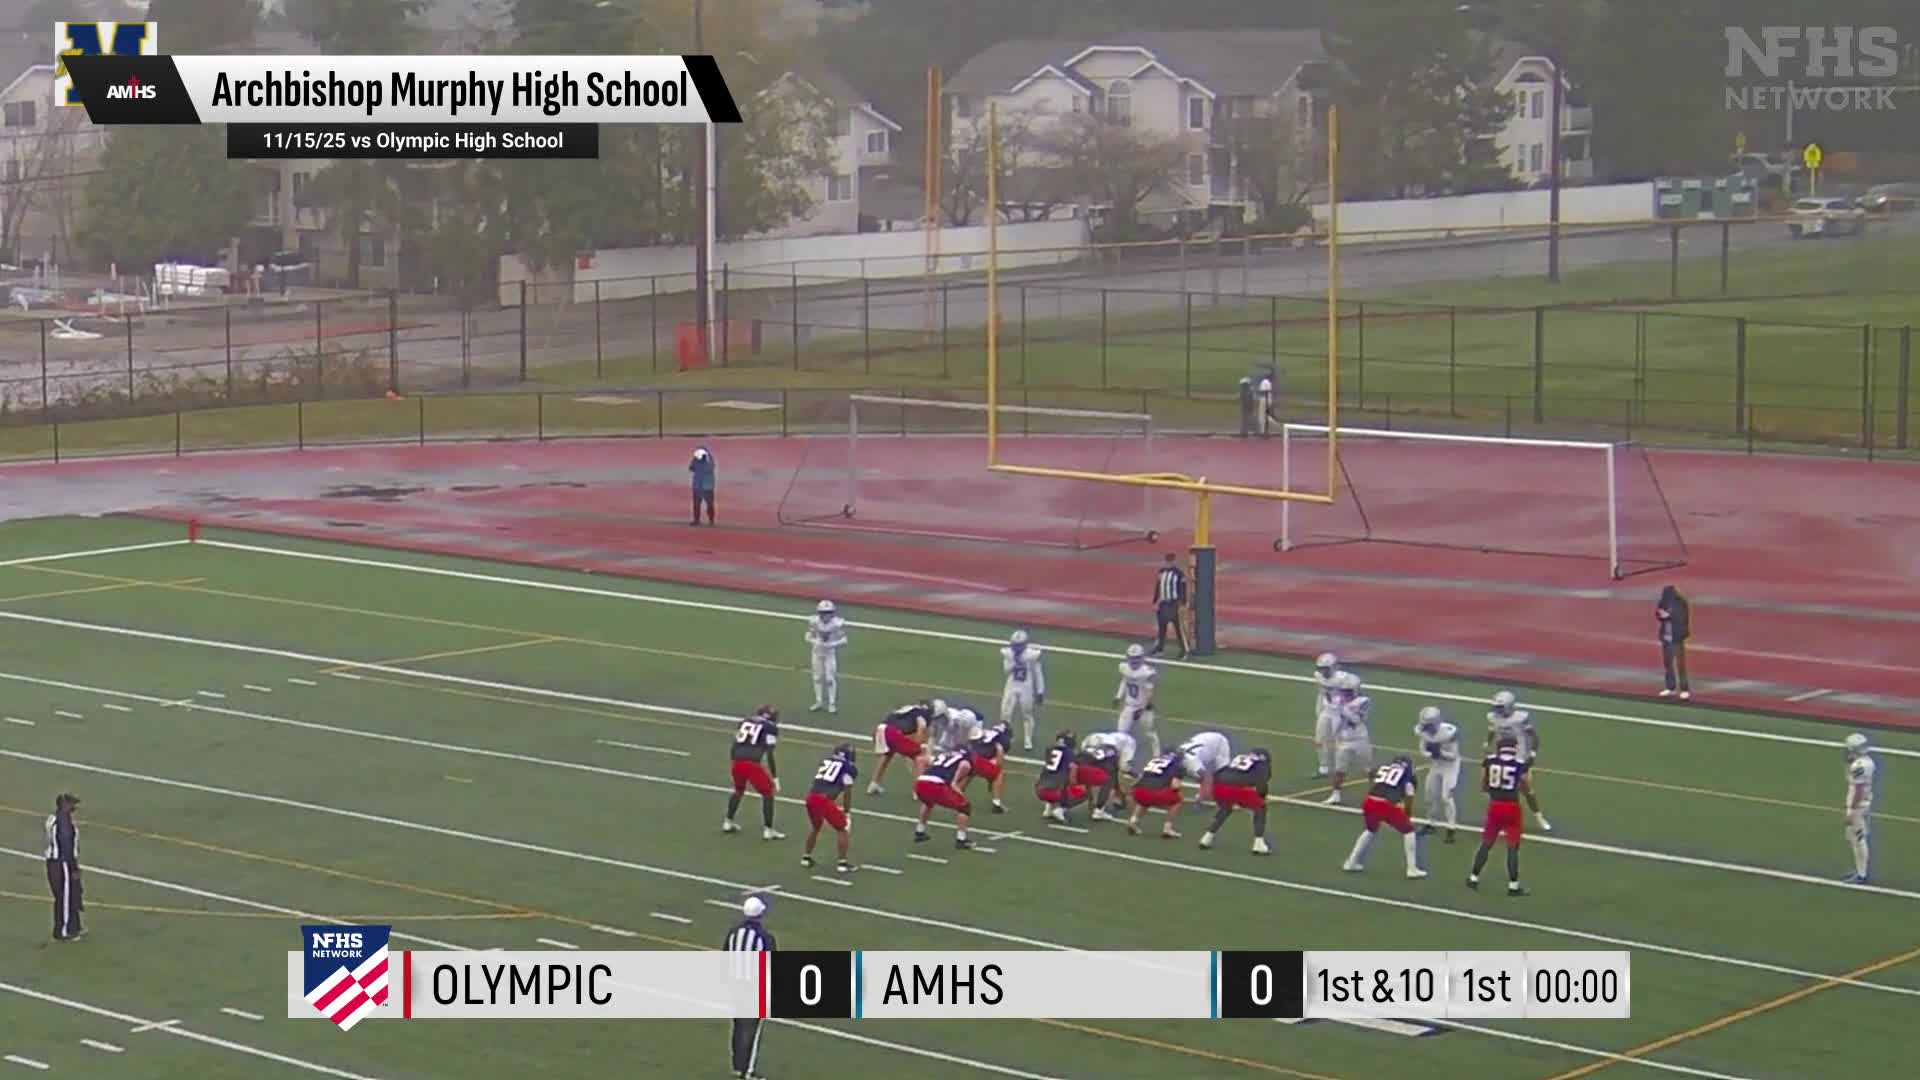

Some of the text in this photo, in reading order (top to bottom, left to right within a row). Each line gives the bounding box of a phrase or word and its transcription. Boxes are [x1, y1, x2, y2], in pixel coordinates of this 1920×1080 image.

[735, 721, 763, 745] 54
[814, 758, 843, 783] 20
[1046, 749, 1063, 771] 3
[1374, 764, 1405, 786] 50
[1488, 764, 1517, 790] 85
